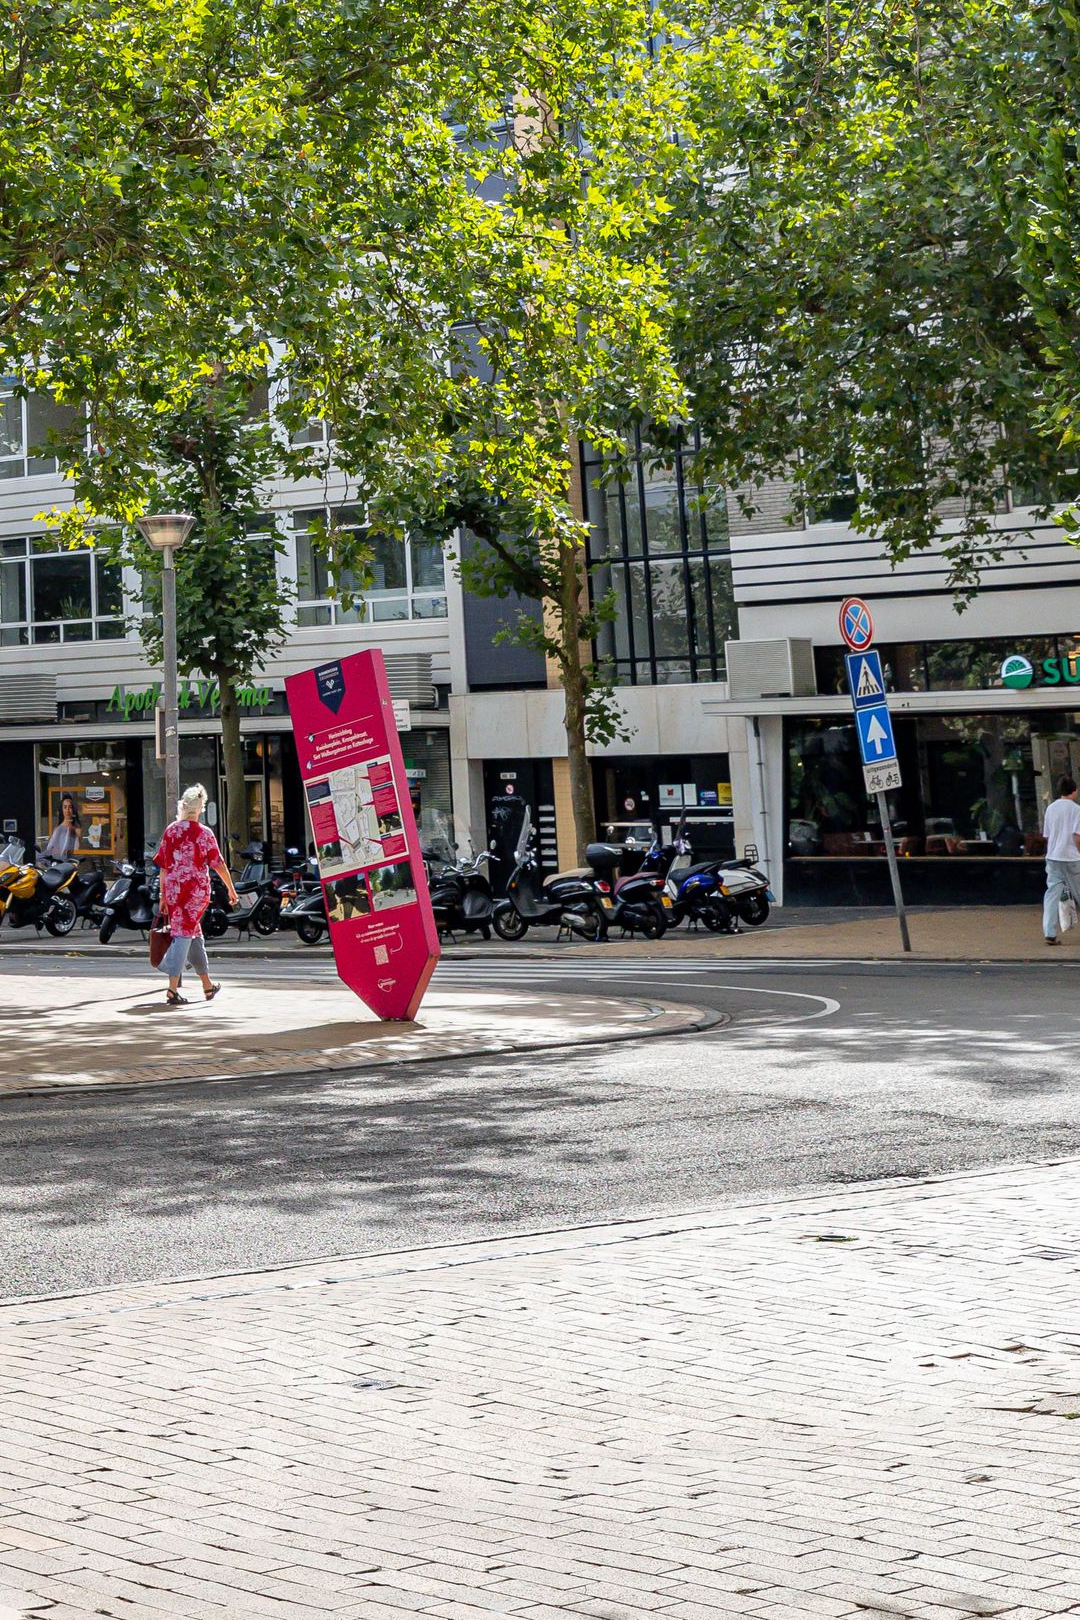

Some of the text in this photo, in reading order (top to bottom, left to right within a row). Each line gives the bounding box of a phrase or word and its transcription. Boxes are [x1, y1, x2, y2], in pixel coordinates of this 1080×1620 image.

[1042, 657, 1080, 685] SU
[105, 679, 270, 721] Apothk Vema
